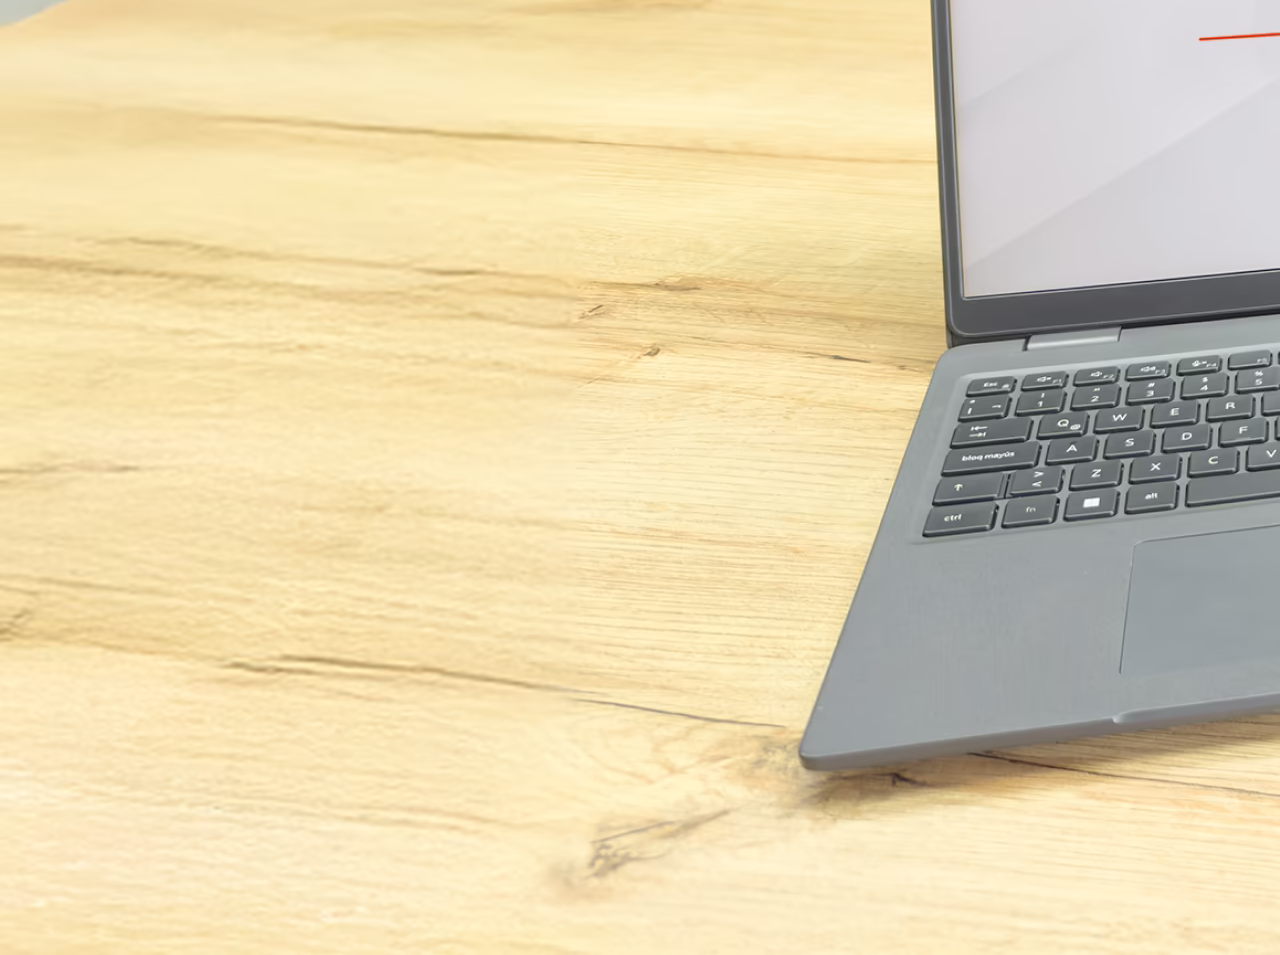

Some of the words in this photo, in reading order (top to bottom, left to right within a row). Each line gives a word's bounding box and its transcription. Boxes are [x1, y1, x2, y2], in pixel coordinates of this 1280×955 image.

[1058, 419, 1069, 427] Q
[1239, 426, 1247, 434] F
[1182, 432, 1192, 440] D
[1208, 456, 1218, 464] C
[1151, 463, 1160, 471] X
[1092, 469, 1101, 477] Z
